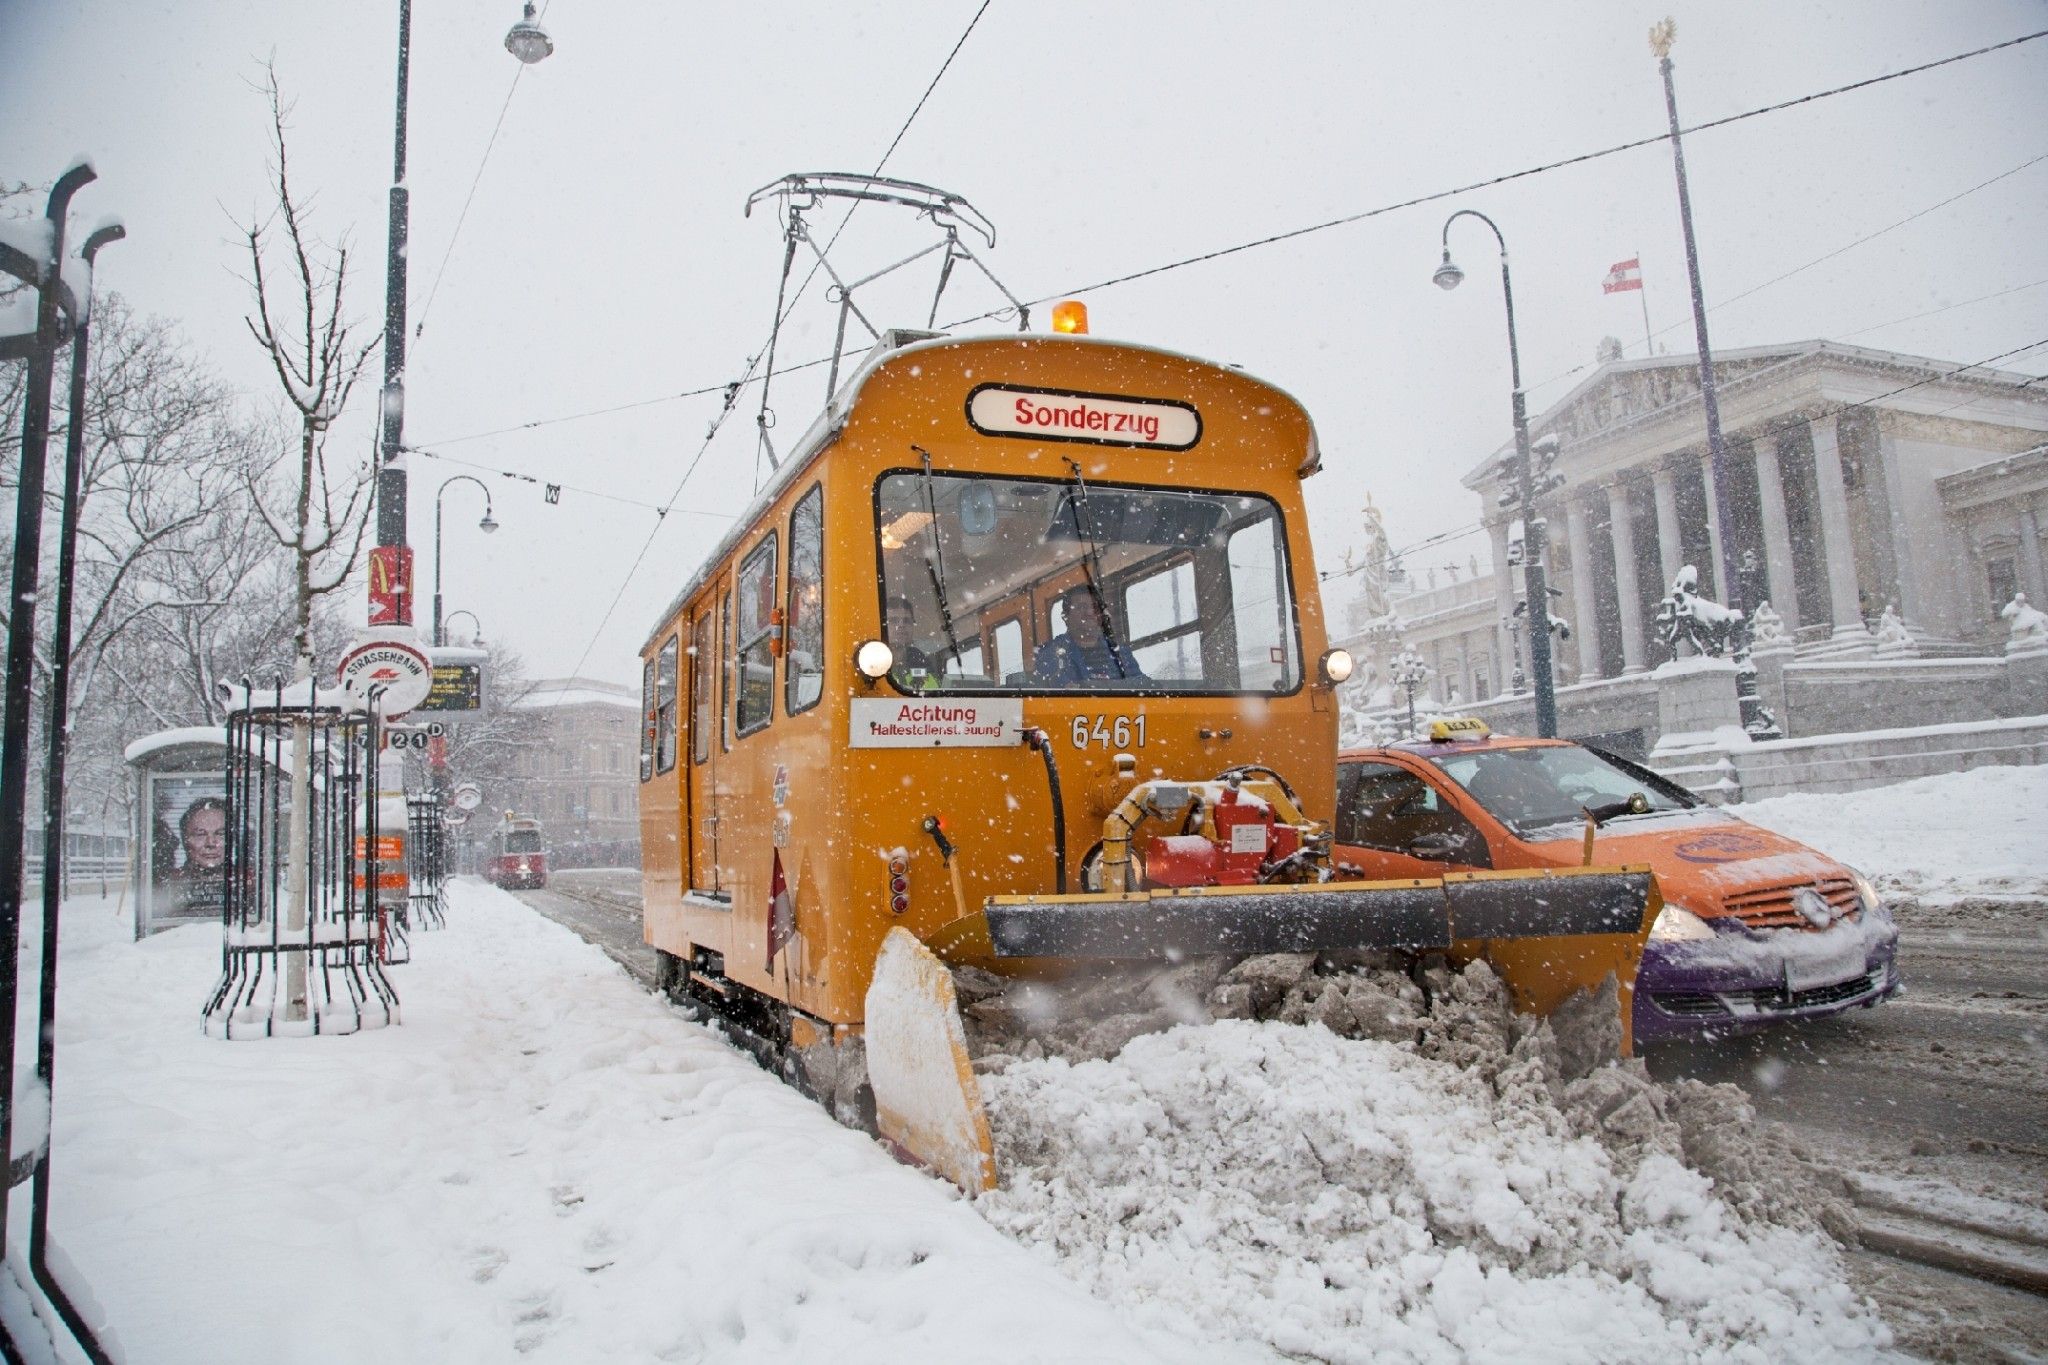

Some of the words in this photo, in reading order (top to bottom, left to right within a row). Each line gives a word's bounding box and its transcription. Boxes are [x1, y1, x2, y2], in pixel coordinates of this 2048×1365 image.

[1015, 398, 1159, 441] Sonderzug
[347, 651, 423, 676] STRASSENBAHN
[897, 704, 976, 724] Achtung
[431, 723, 443, 737] D
[871, 724, 1001, 737] Haltestellensteuung
[1072, 714, 1146, 749] 6461
[395, 734, 406, 747] 2
[416, 734, 424, 747] 1
